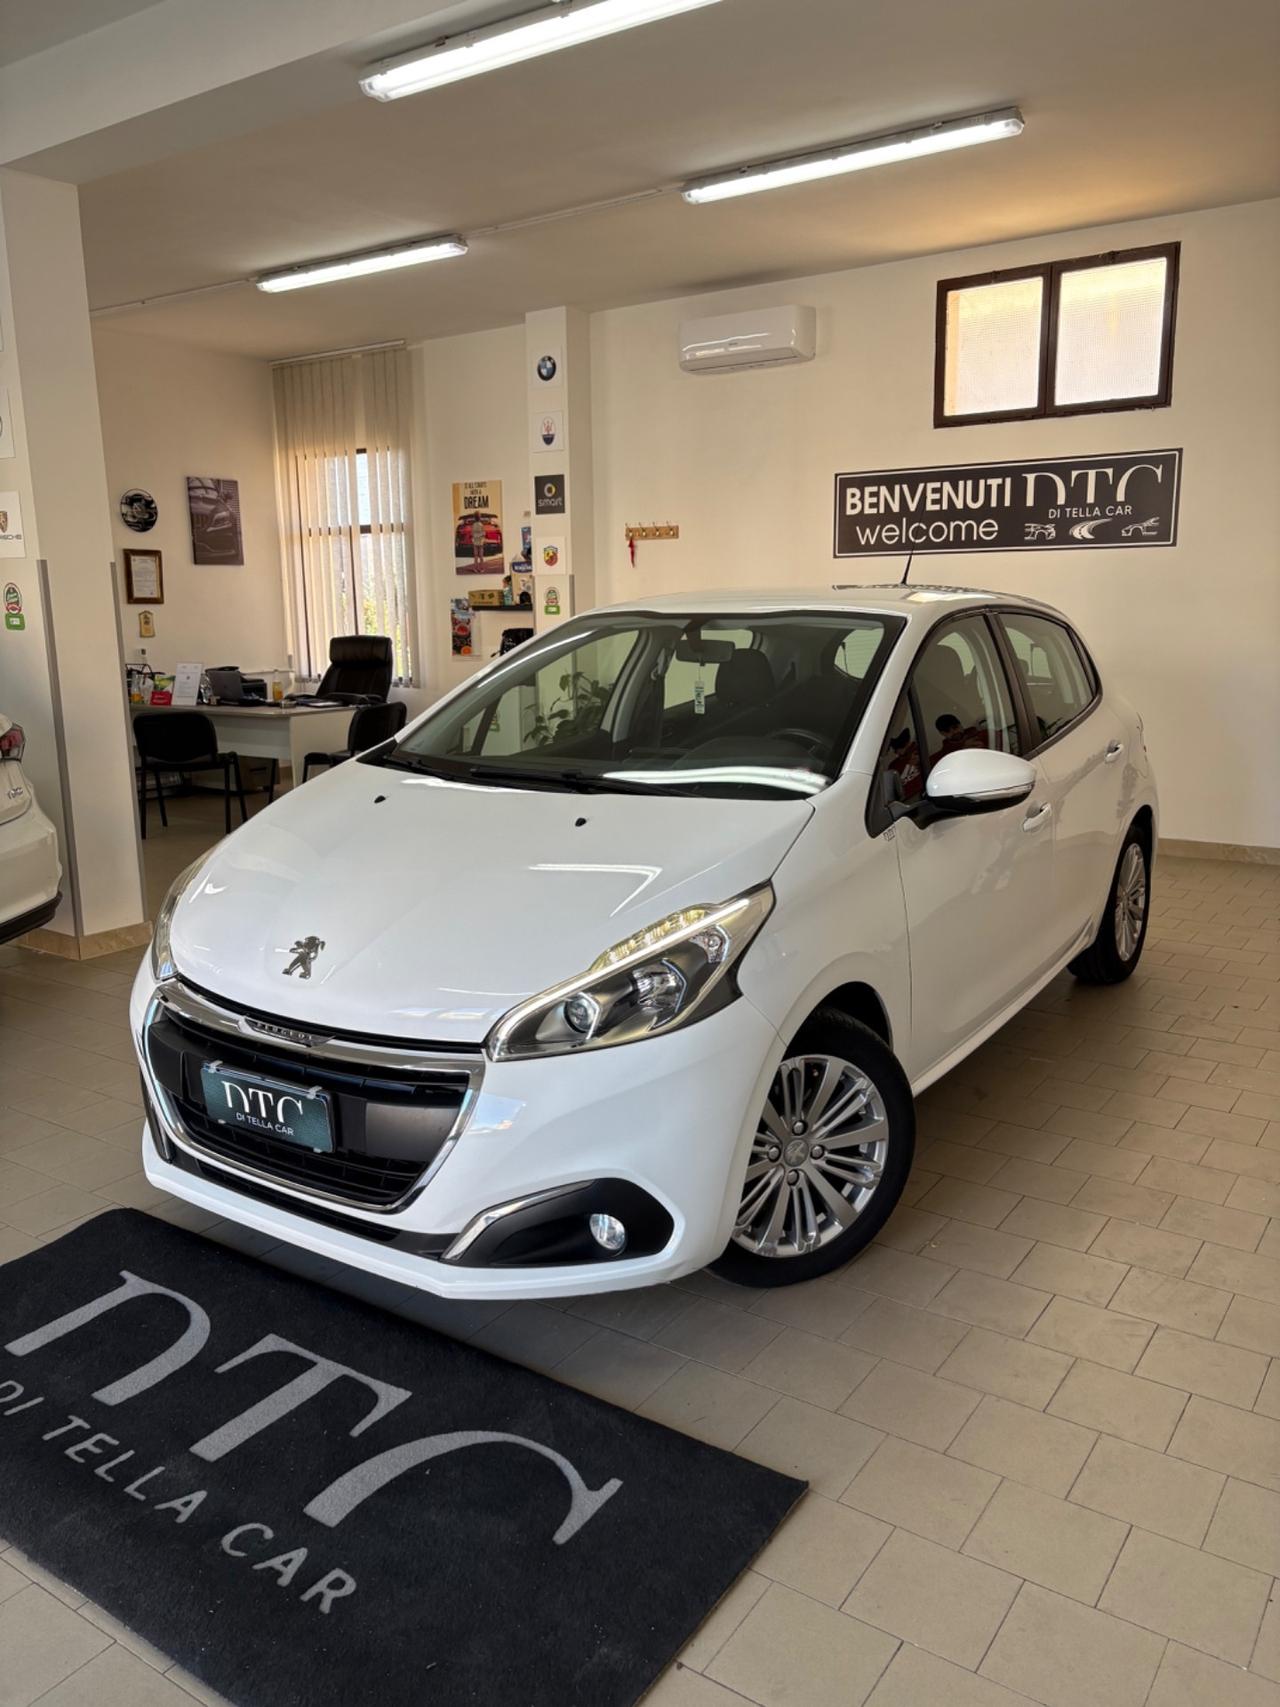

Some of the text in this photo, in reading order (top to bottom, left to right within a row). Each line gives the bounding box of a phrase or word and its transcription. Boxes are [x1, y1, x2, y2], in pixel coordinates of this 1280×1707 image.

[845, 477, 1012, 515] BENVENUTI
[1021, 464, 1163, 507] DTC
[463, 495, 489, 510] DREAM
[538, 497, 563, 507] smart
[1048, 504, 1133, 519] DI TELLA CAR
[856, 517, 998, 545] welcome
[221, 1081, 304, 1123] DTC
[236, 1112, 295, 1136] DI TELLA CAR
[42, 1415, 208, 1523] TELLA
[221, 1523, 357, 1614] CAR
